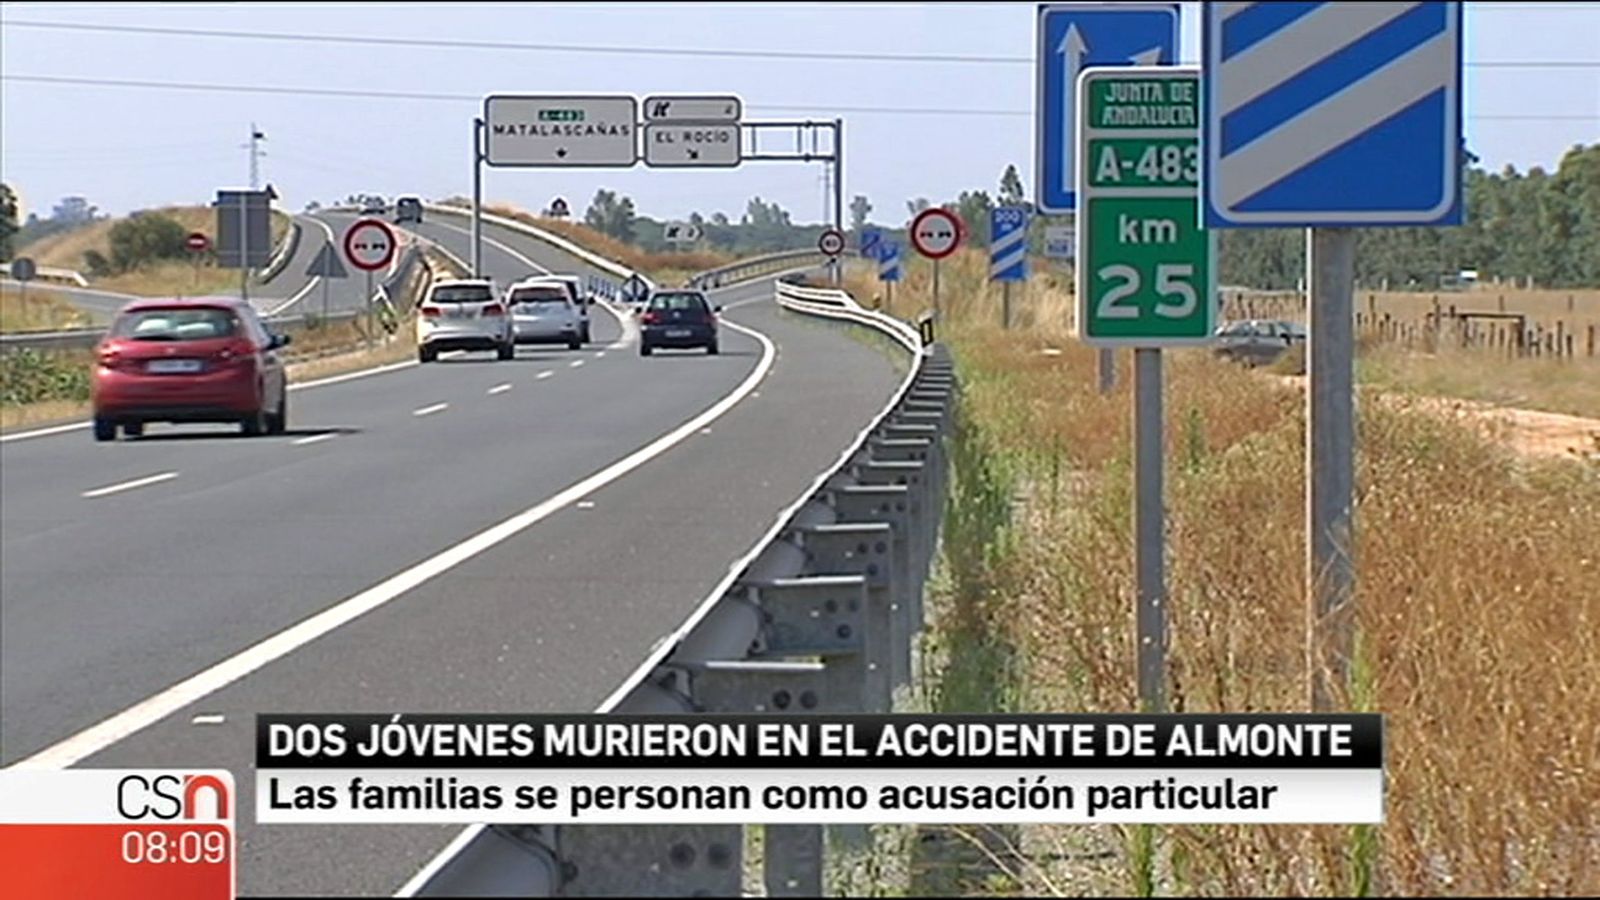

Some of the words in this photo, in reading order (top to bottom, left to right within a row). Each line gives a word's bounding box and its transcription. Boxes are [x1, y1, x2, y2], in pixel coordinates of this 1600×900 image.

[1104, 82, 1163, 102] JUNTA
[1170, 82, 1194, 102] DE
[493, 122, 630, 136] MATALASCAÑAS
[656, 131, 675, 143] EL
[1096, 145, 1199, 182] A-483
[1118, 214, 1177, 243] km
[1097, 263, 1198, 318] 25
